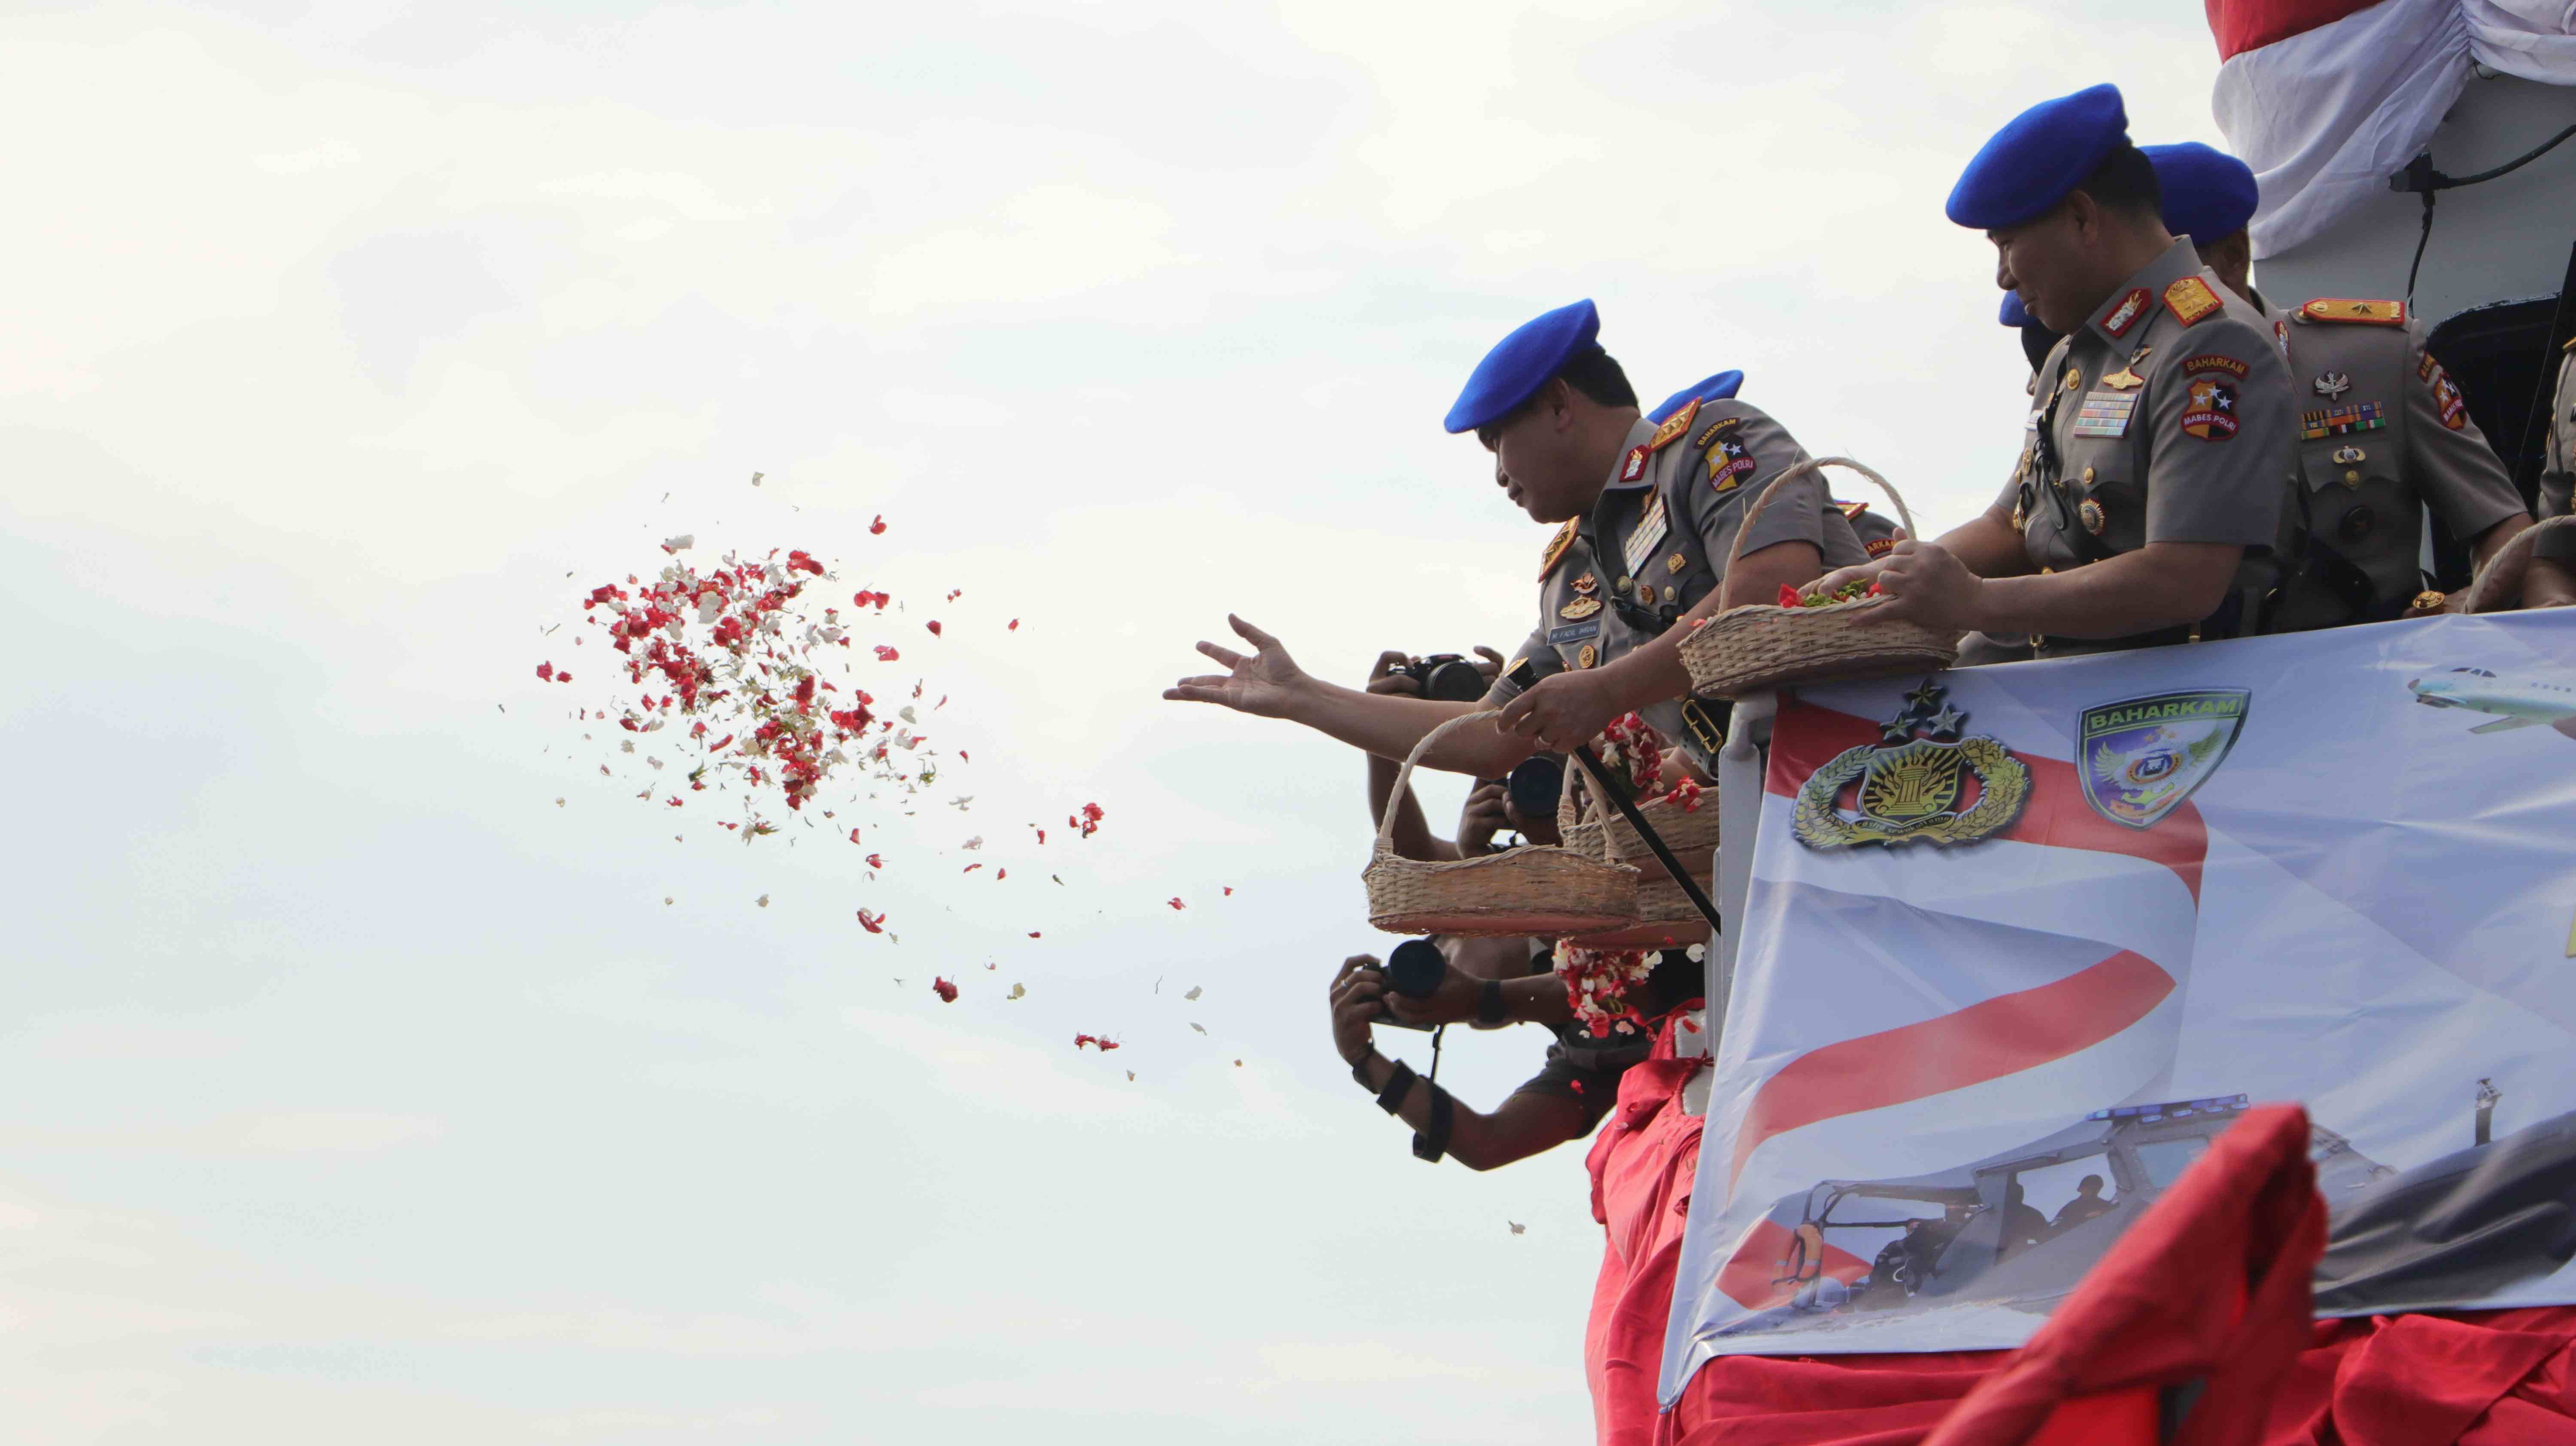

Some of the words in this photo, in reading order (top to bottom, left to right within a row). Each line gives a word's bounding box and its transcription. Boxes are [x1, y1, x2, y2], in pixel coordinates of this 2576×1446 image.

[2187, 357, 2245, 374] BAHARKAM
[1698, 419, 1736, 445] BAHARKAM
[2184, 414, 2211, 425] MABES
[2214, 415, 2236, 431] POLRI
[1712, 465, 1732, 489] MABES
[1732, 459, 1753, 471] POLRI
[2090, 700, 2237, 729] BAHARKAM
